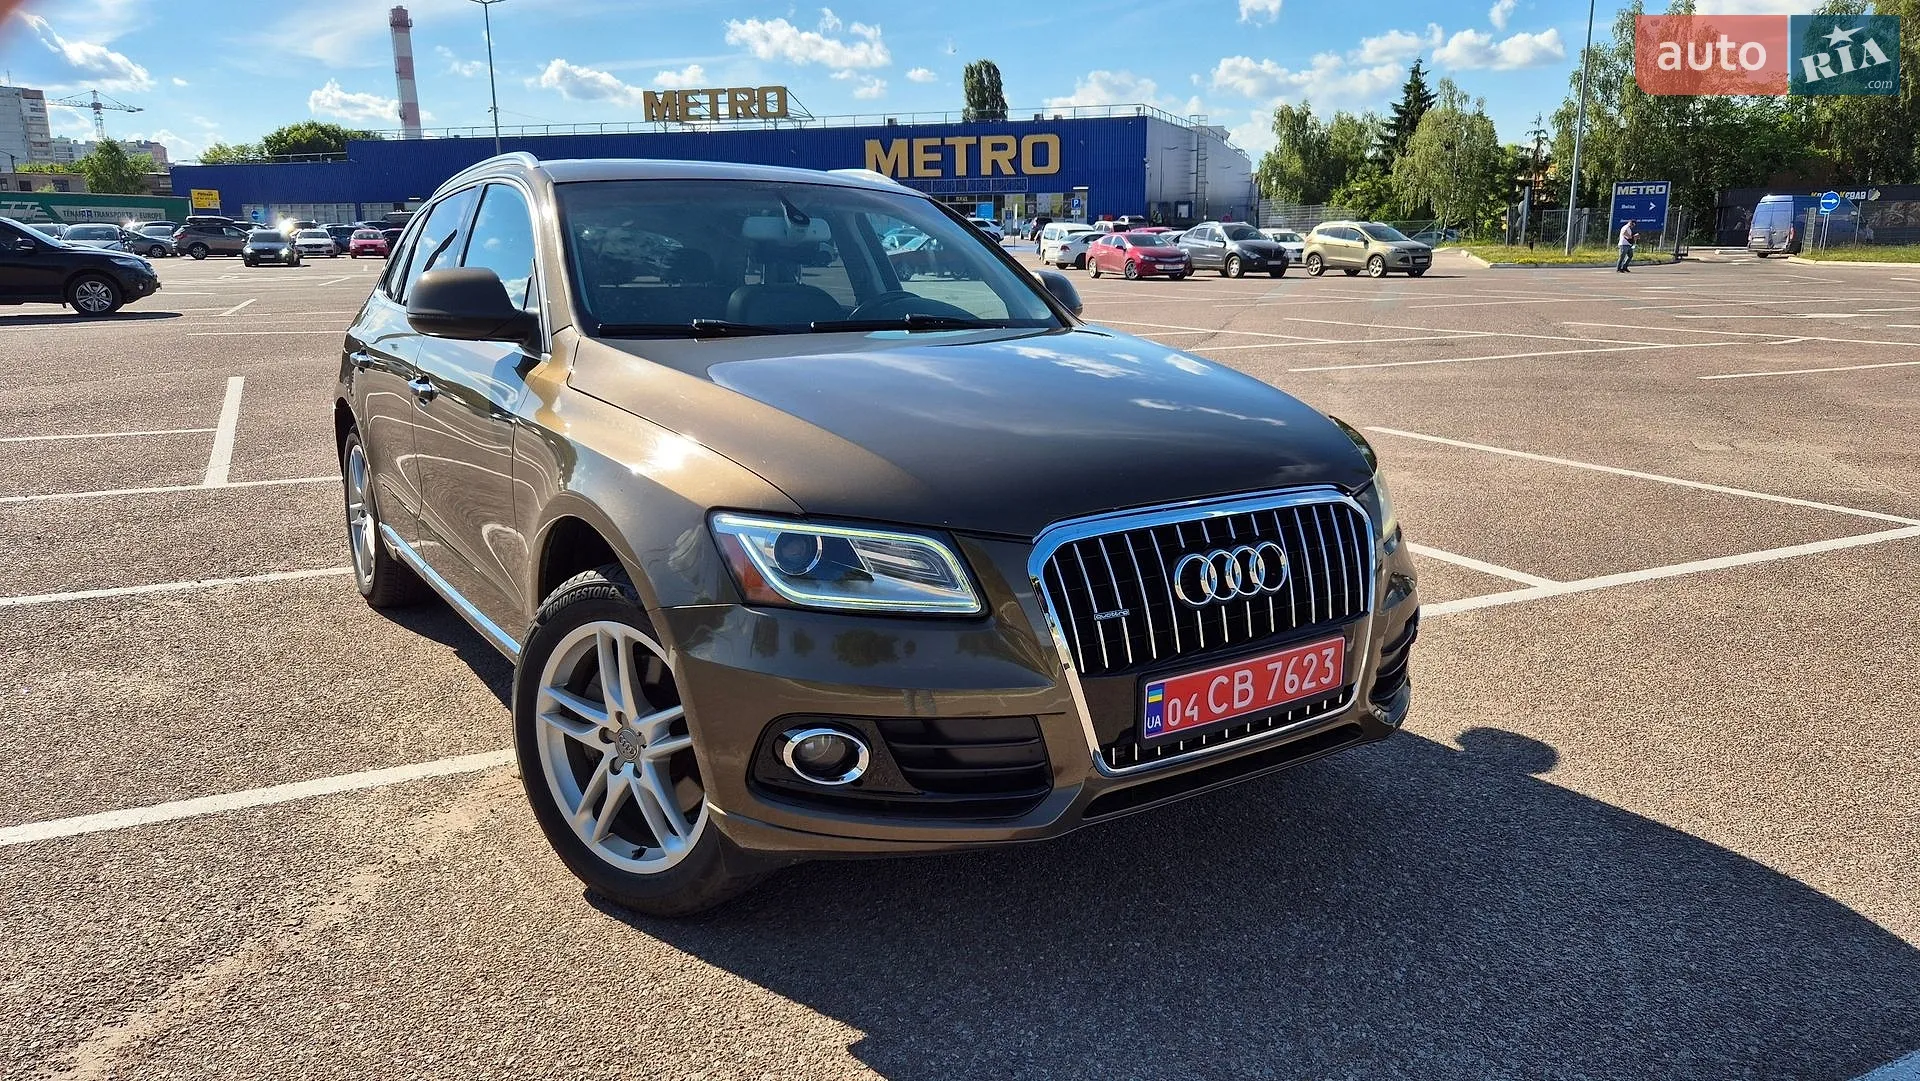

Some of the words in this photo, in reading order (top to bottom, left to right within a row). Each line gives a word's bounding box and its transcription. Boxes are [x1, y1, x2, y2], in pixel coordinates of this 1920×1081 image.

[643, 85, 788, 121] METRO
[865, 133, 1060, 178] METRO
[1616, 185, 1667, 195] METRO
[93, 210, 133, 219] TRANSPORTS
[545, 585, 616, 618] BRIDGESTONE
[1095, 610, 1129, 620] quattro
[1168, 693, 1199, 726] 04
[1207, 669, 1255, 715] CB
[1266, 647, 1335, 701] 7623
[1147, 715, 1162, 729] UA
